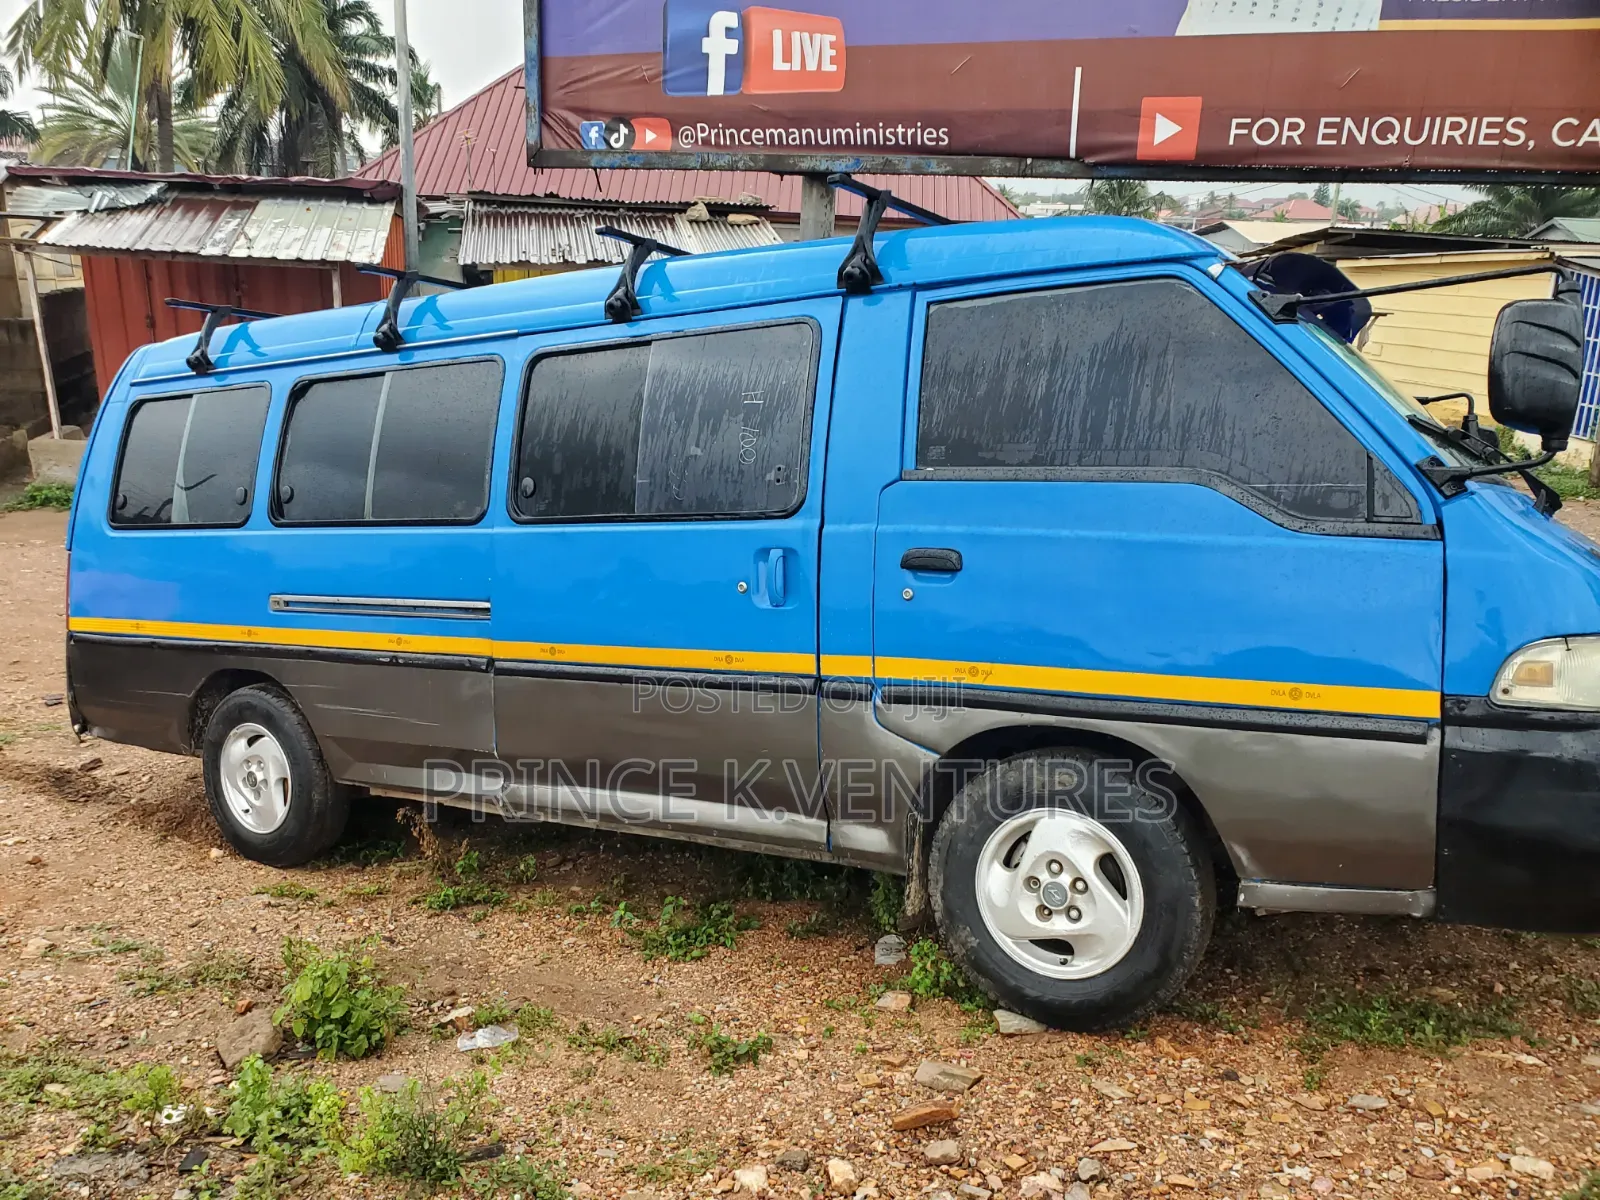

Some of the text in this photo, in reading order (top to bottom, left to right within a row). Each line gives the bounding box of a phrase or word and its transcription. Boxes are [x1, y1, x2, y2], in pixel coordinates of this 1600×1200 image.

[772, 29, 838, 72] LIVE
[678, 122, 949, 150] @Princemanuministries
[1228, 117, 1306, 146] FOR
[1316, 116, 1535, 151] ENQUIRIES,
[954, 667, 967, 675] DVLA
[1270, 688, 1321, 699] DVLA DVLA
